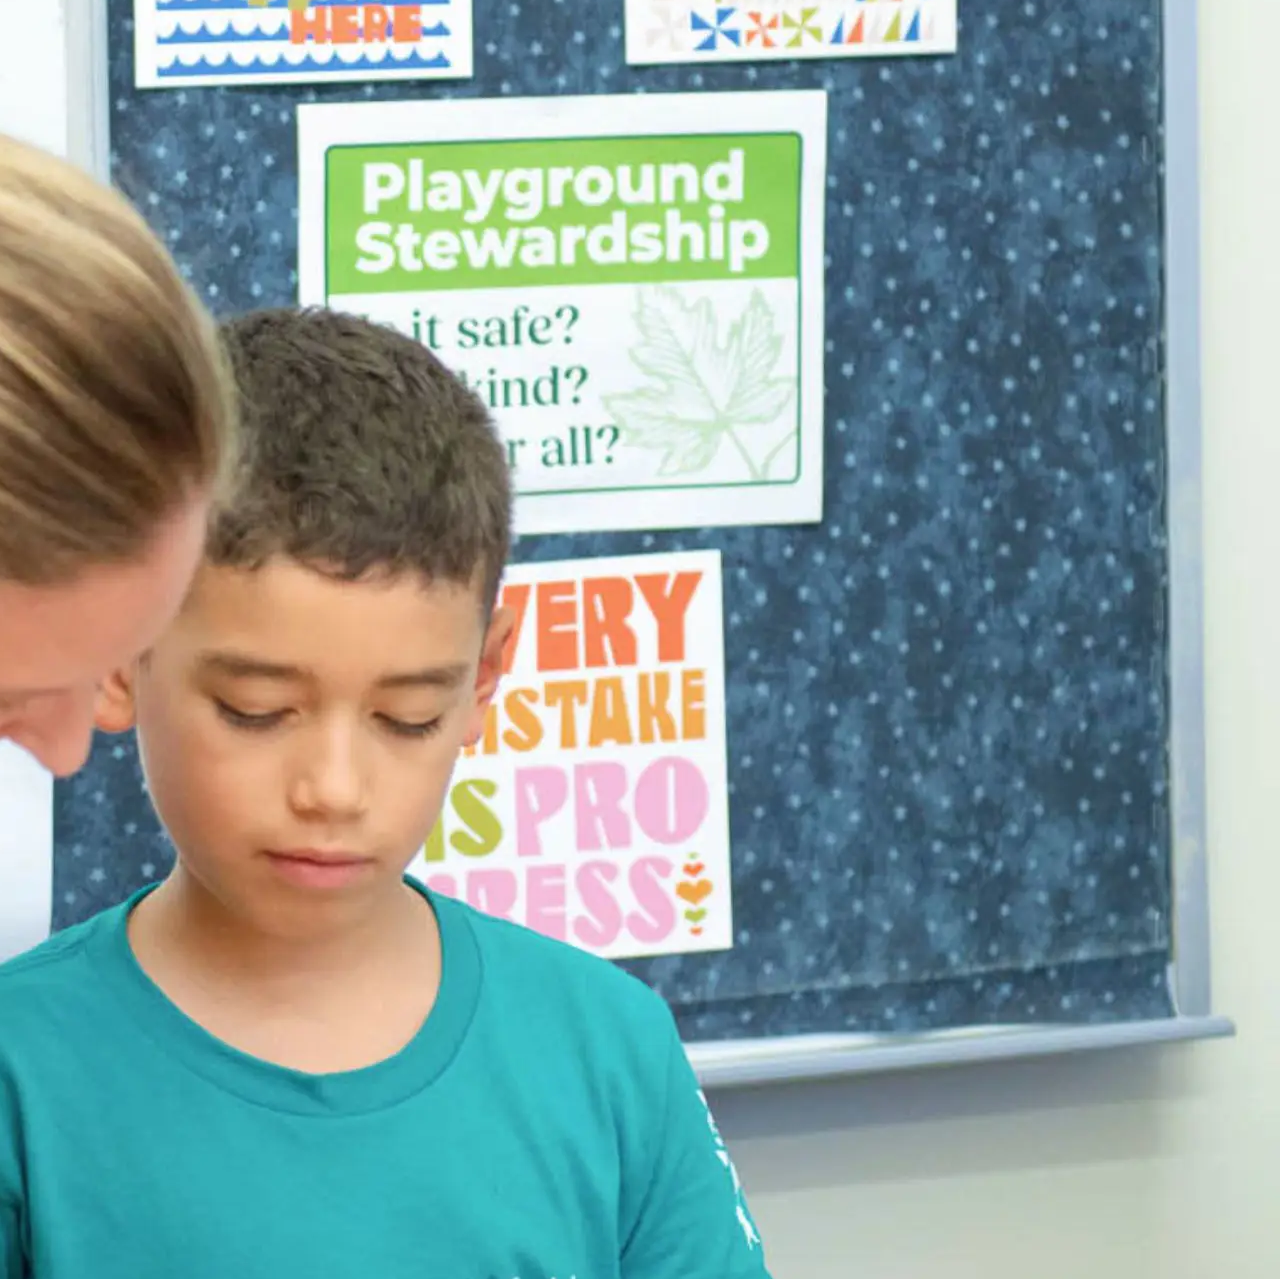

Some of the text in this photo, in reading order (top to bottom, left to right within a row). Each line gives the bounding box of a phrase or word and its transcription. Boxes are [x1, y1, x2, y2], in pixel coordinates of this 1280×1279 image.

[290, 3, 422, 46] HERE
[362, 148, 745, 223] Playground
[355, 205, 770, 274] Stewardship
[413, 309, 441, 350] it
[457, 304, 580, 349] safe?
[540, 424, 622, 468] all?
[497, 570, 703, 675] VERY
[457, 668, 706, 759] ISTAKE
[514, 756, 710, 857] PRO
